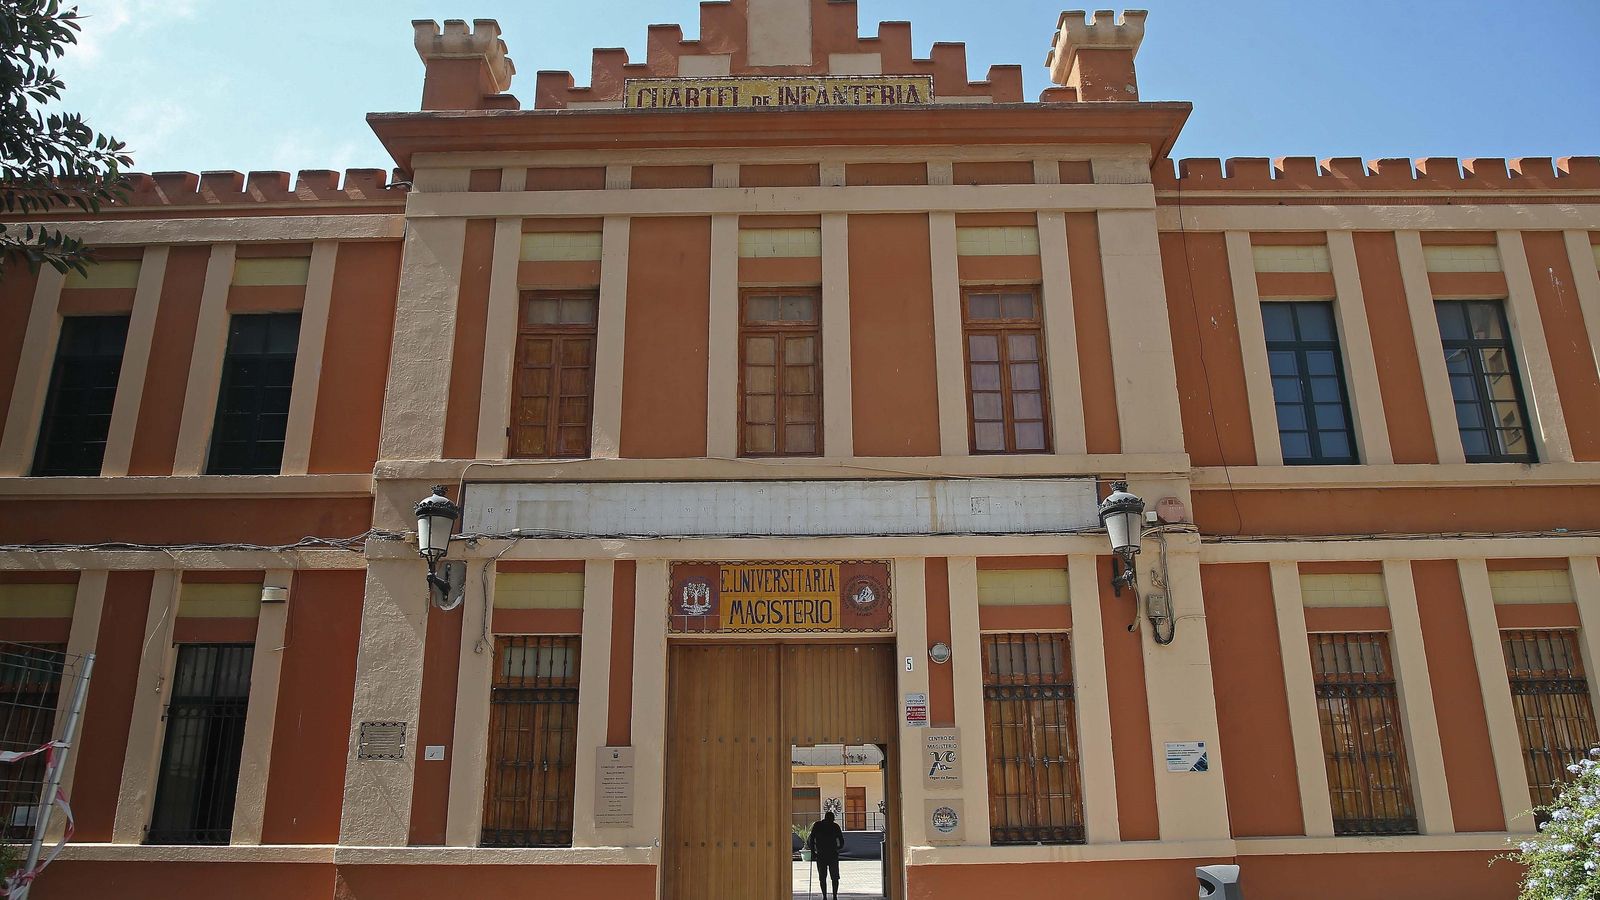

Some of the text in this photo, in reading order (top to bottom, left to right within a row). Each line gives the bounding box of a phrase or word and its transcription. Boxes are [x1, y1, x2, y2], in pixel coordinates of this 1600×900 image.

[637, 85, 921, 107] CUARTEL DE INFANTERIA
[729, 599, 832, 625] MAGISTERIO
[906, 658, 912, 671] 5
